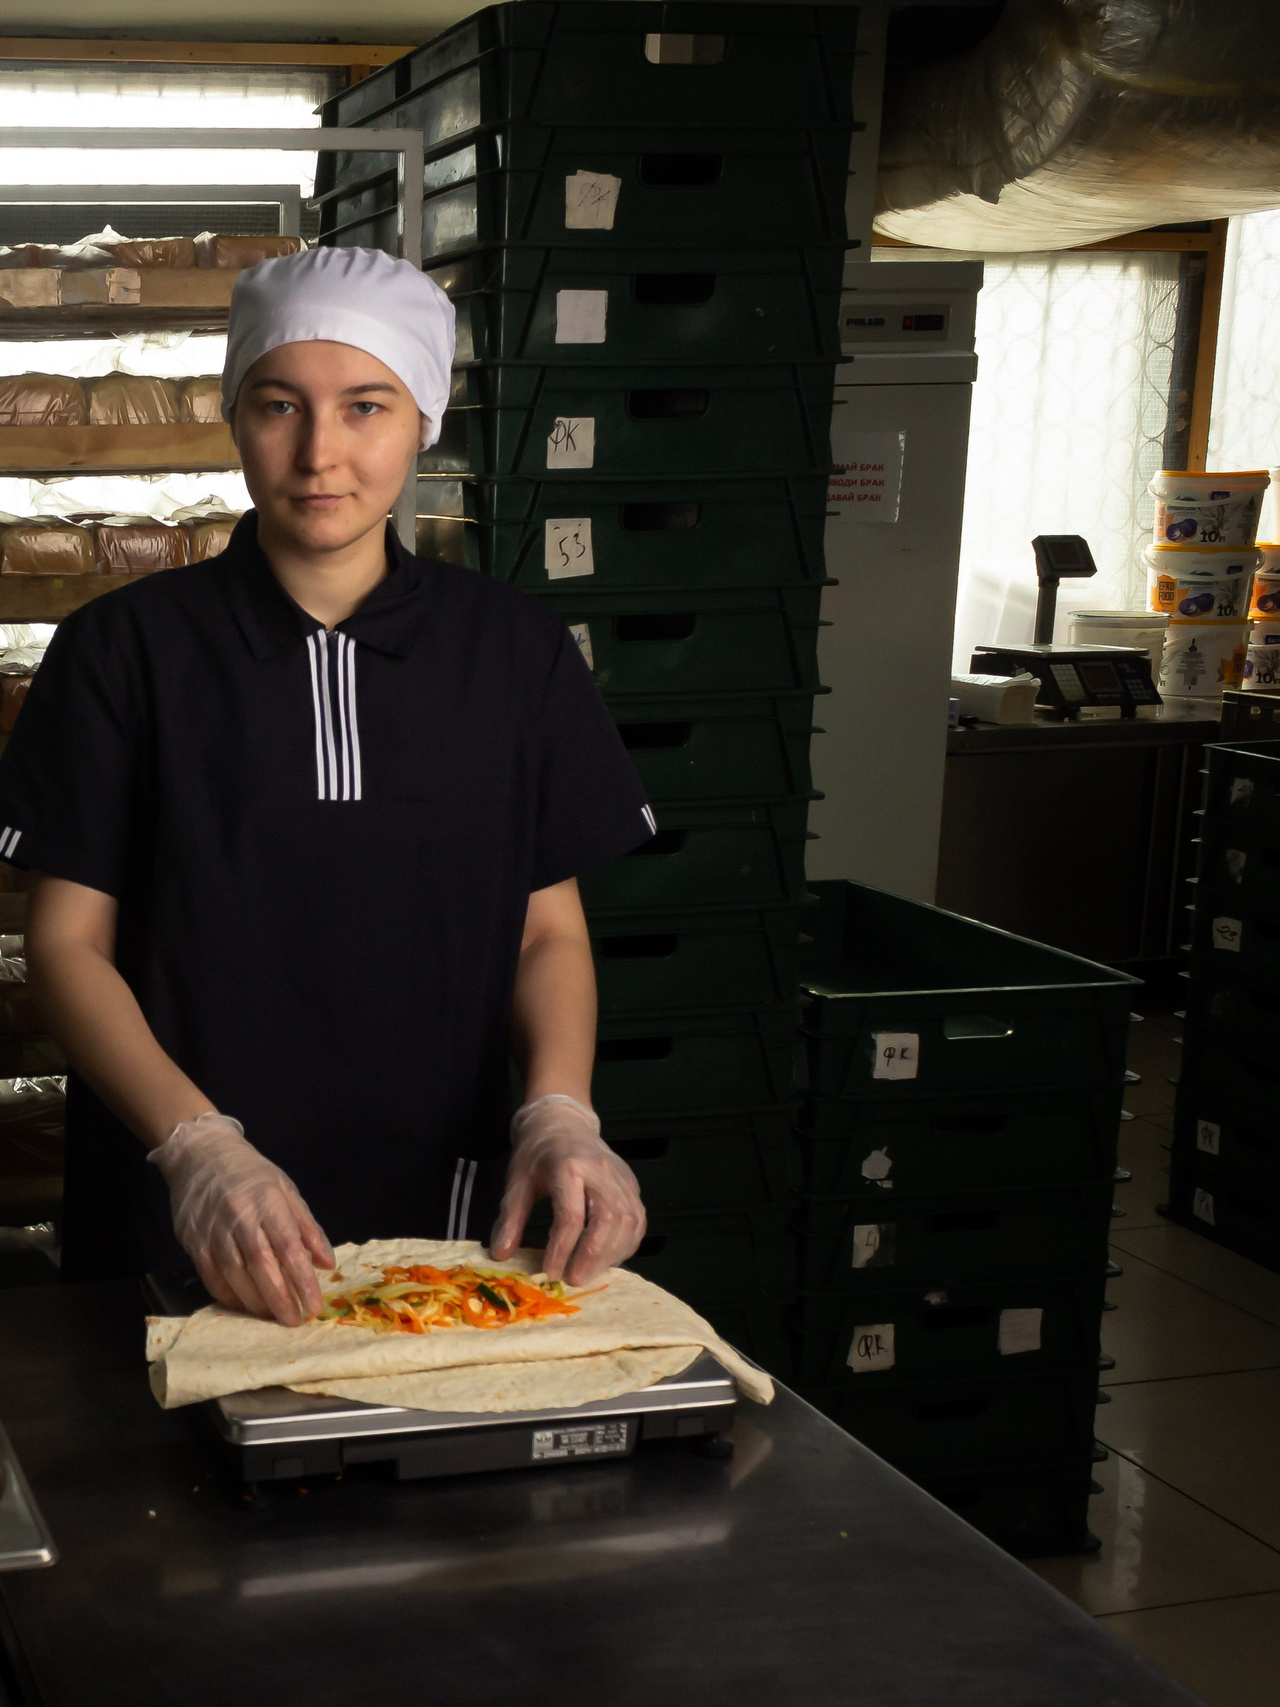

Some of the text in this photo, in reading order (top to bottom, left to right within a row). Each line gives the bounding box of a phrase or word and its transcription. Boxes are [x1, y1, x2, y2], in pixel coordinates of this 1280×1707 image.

[860, 463, 885, 471] БРАК
[860, 478, 885, 487] БРАК
[857, 493, 881, 502] БРАК
